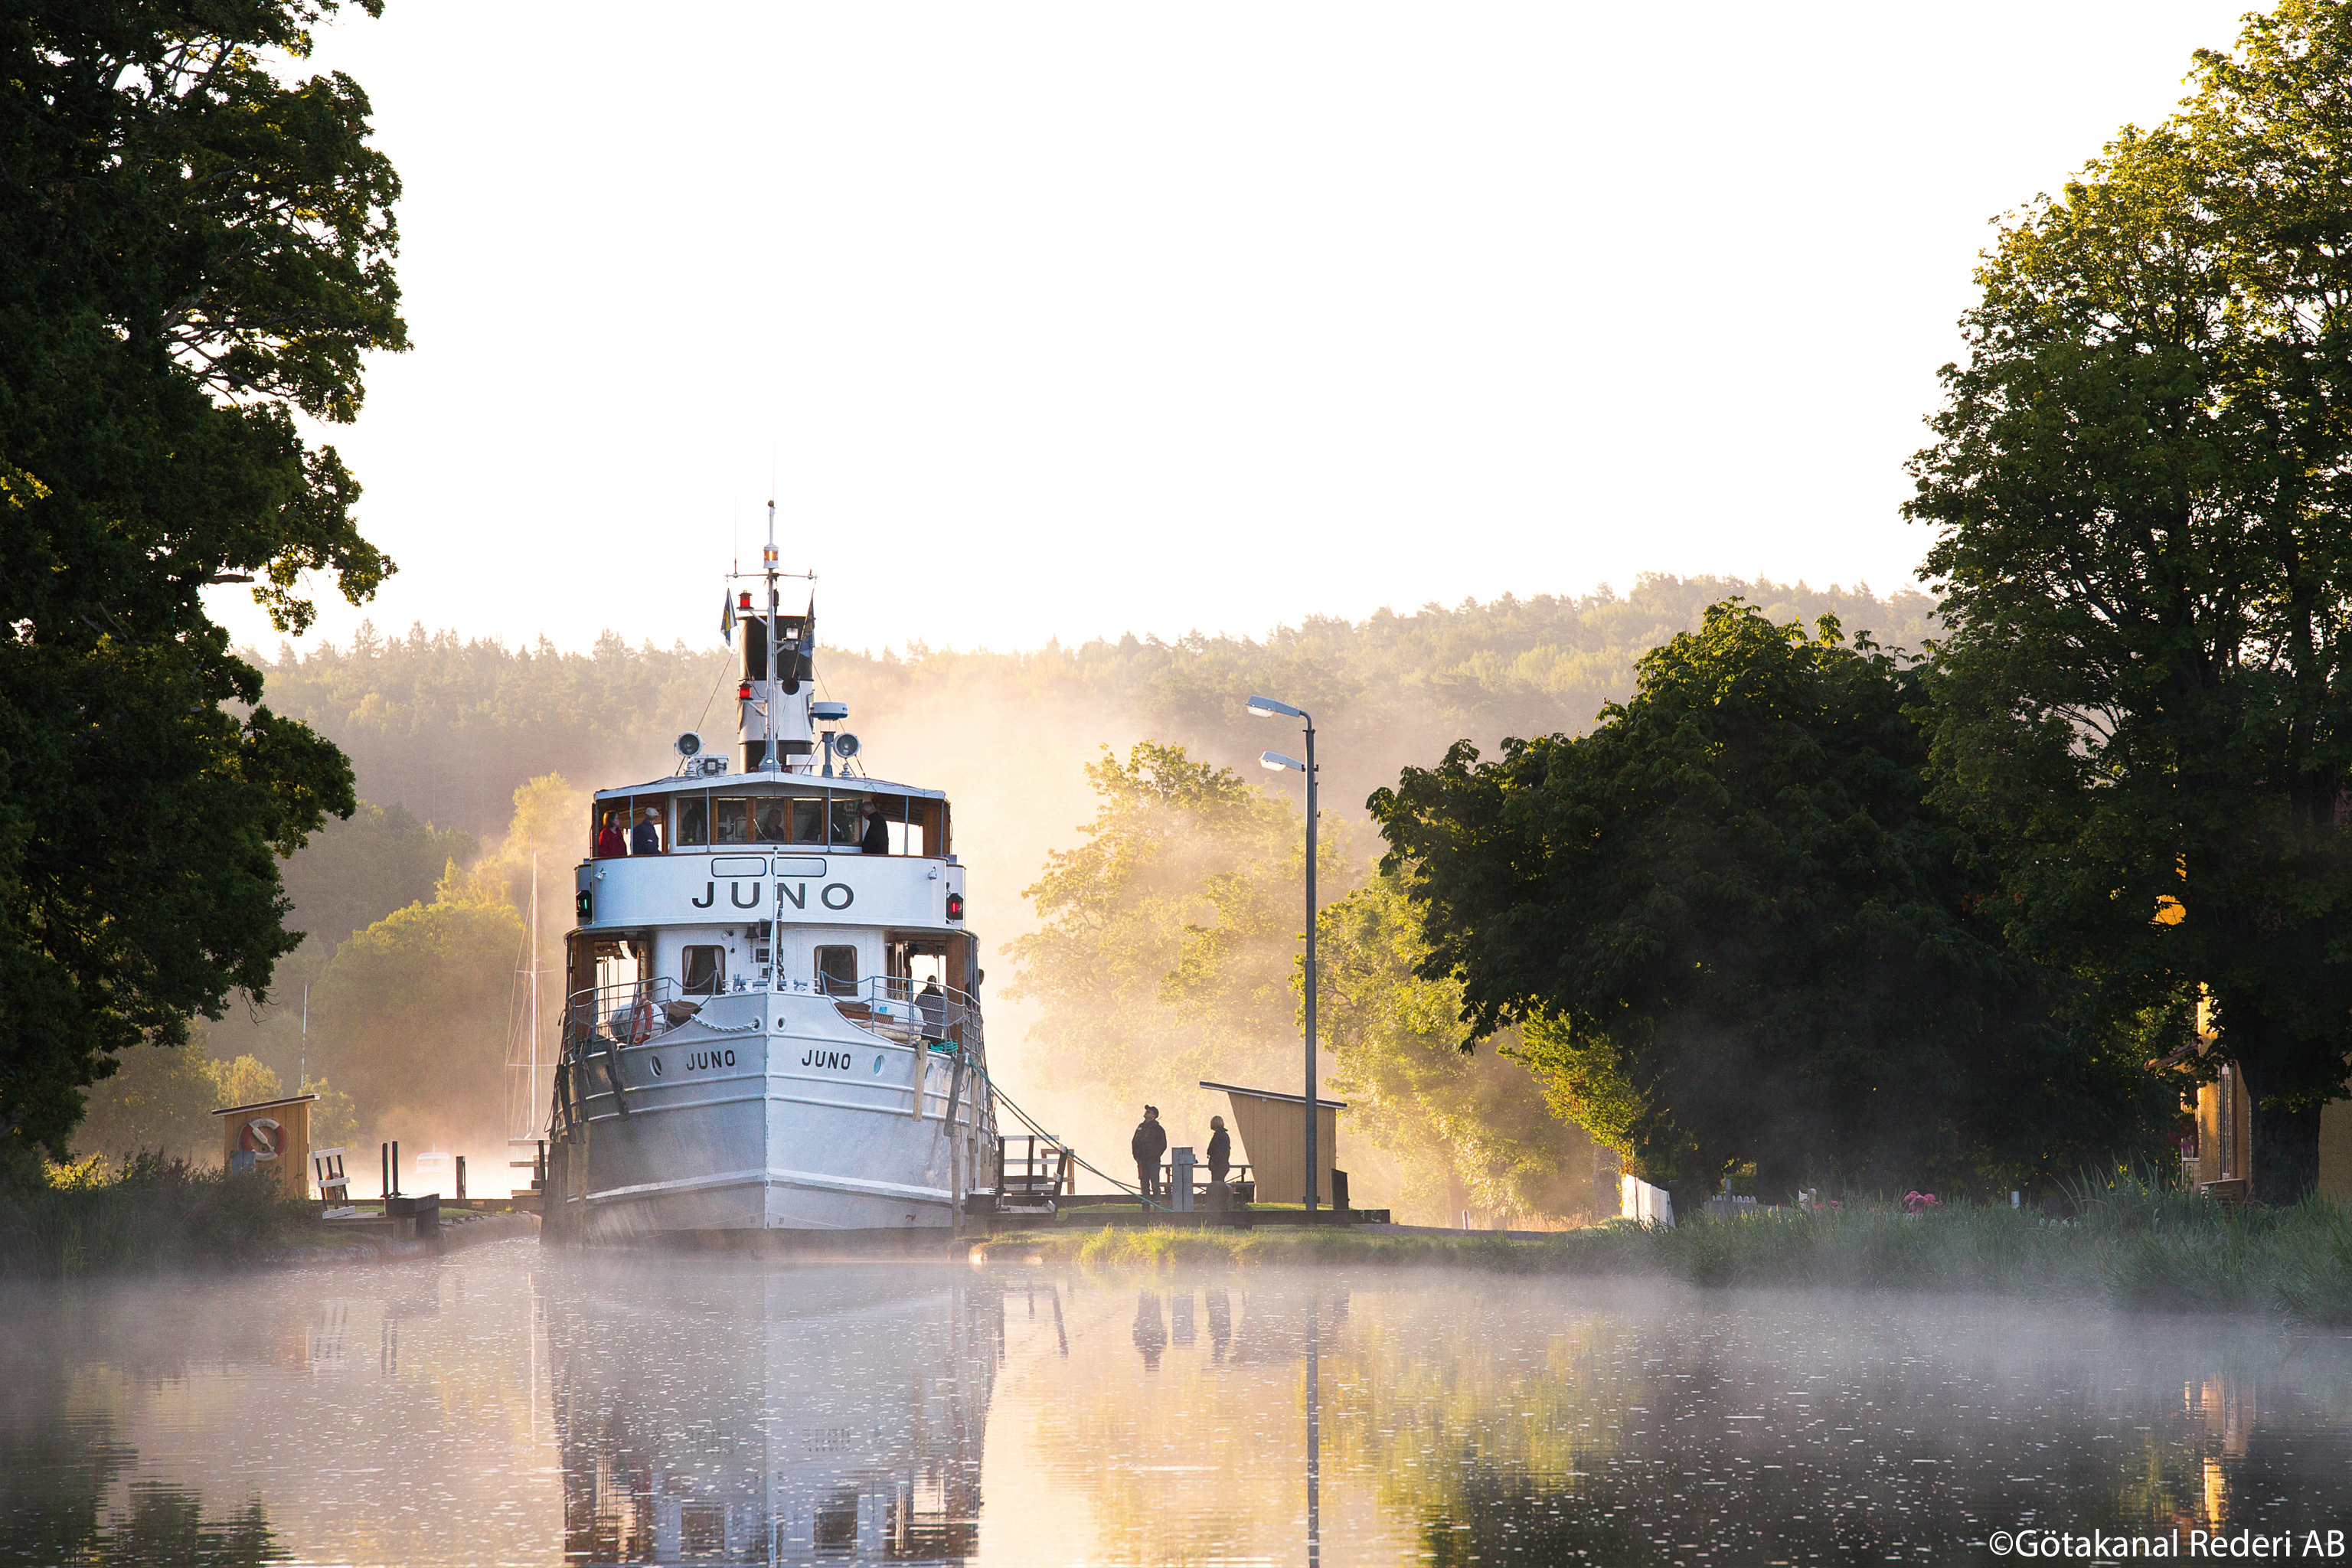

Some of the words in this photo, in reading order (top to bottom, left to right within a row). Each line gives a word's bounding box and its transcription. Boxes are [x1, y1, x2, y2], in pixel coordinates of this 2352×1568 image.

[691, 881, 854, 910] JUNO
[686, 1050, 736, 1070] JUNO
[802, 1050, 851, 1070] JUNO
